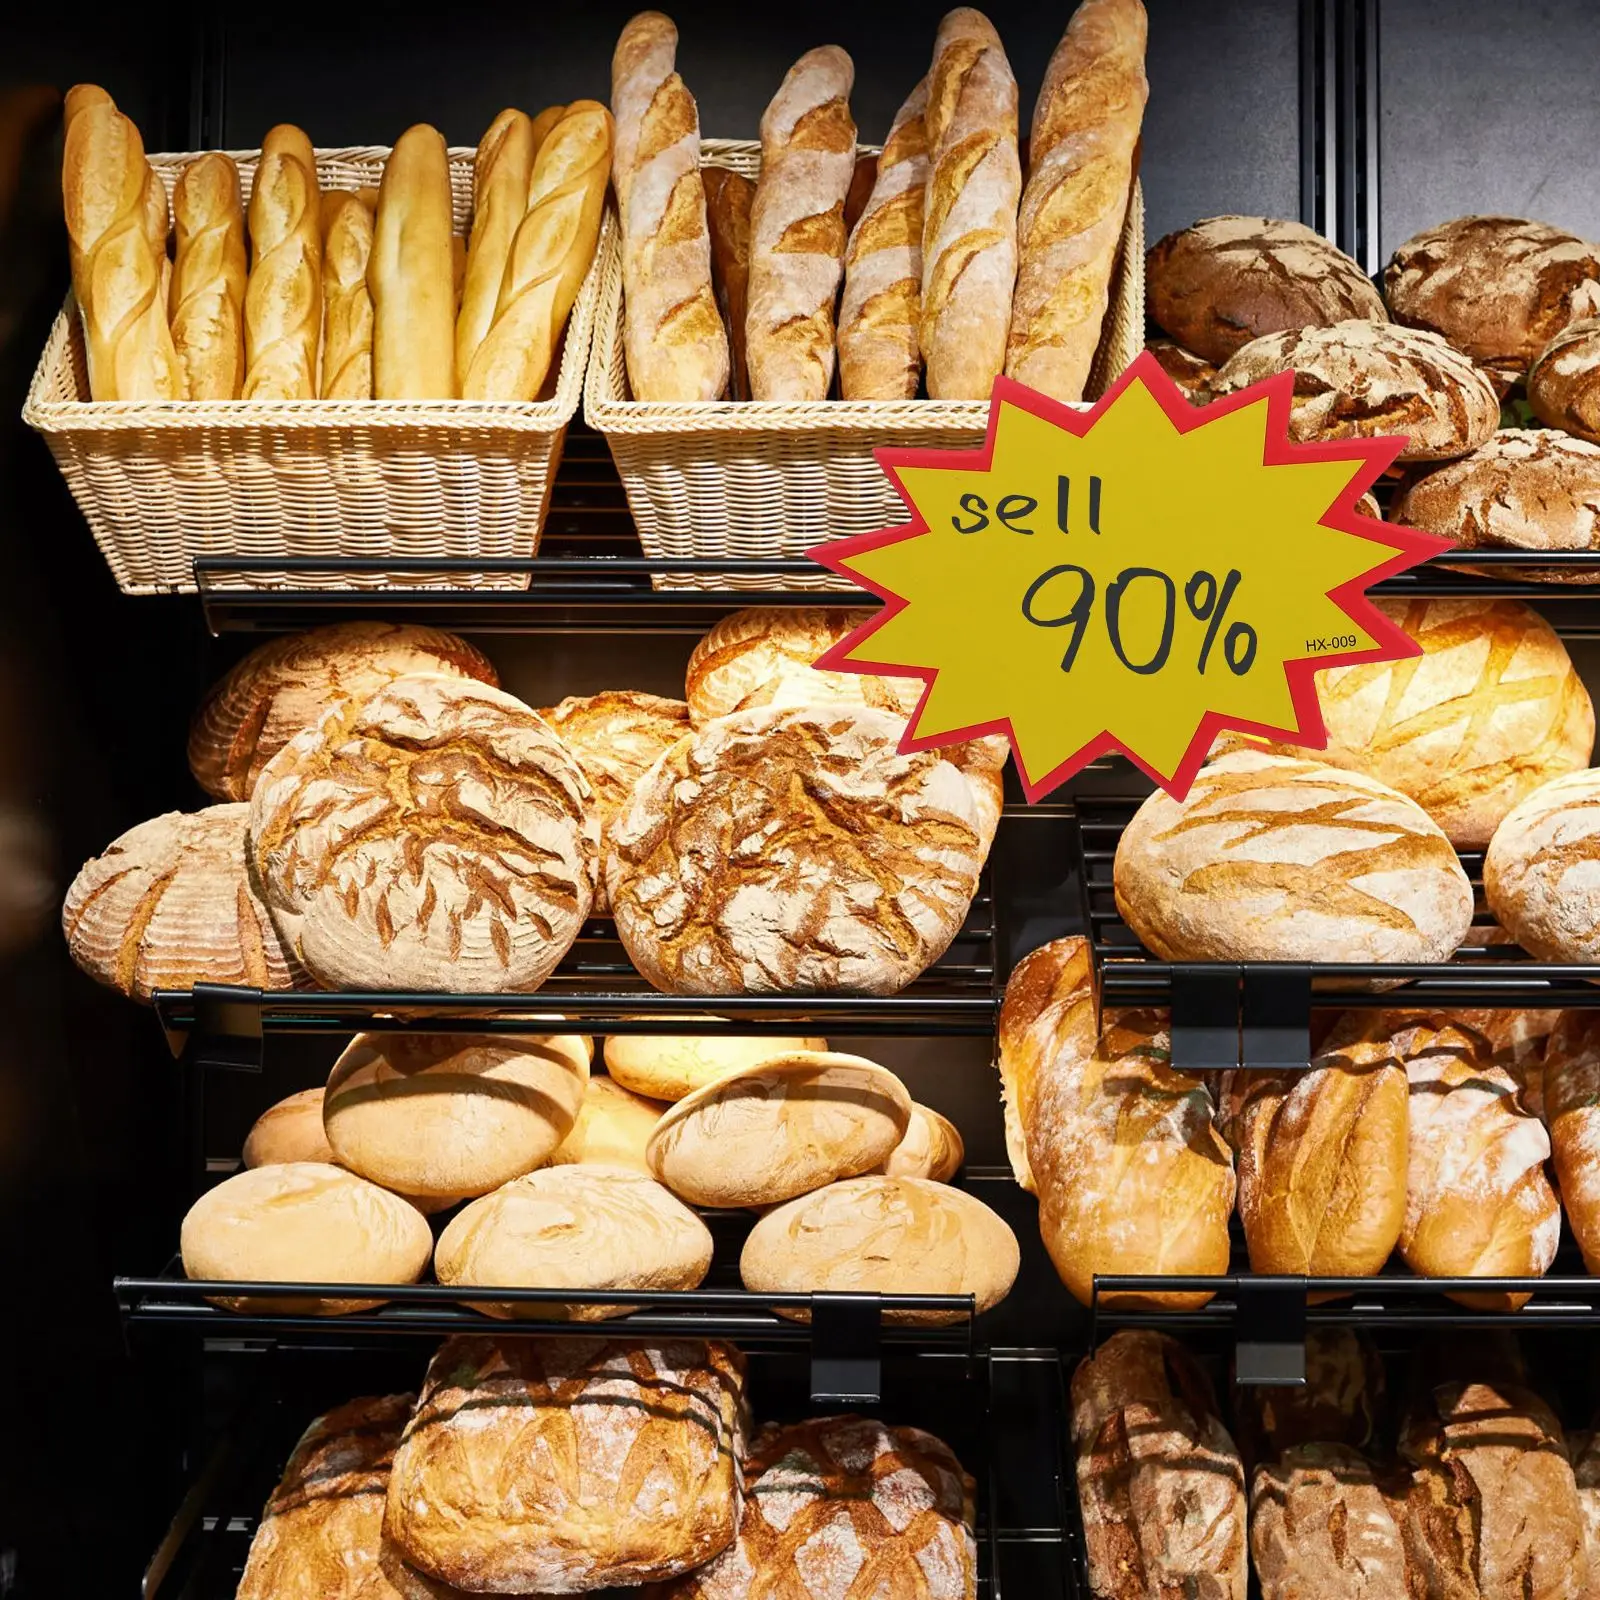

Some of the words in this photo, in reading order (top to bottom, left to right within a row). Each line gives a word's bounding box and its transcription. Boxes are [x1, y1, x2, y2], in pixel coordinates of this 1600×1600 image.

[951, 475, 1102, 536] sell
[1022, 565, 1258, 676] 90%
[1305, 635, 1357, 653] HX-009
